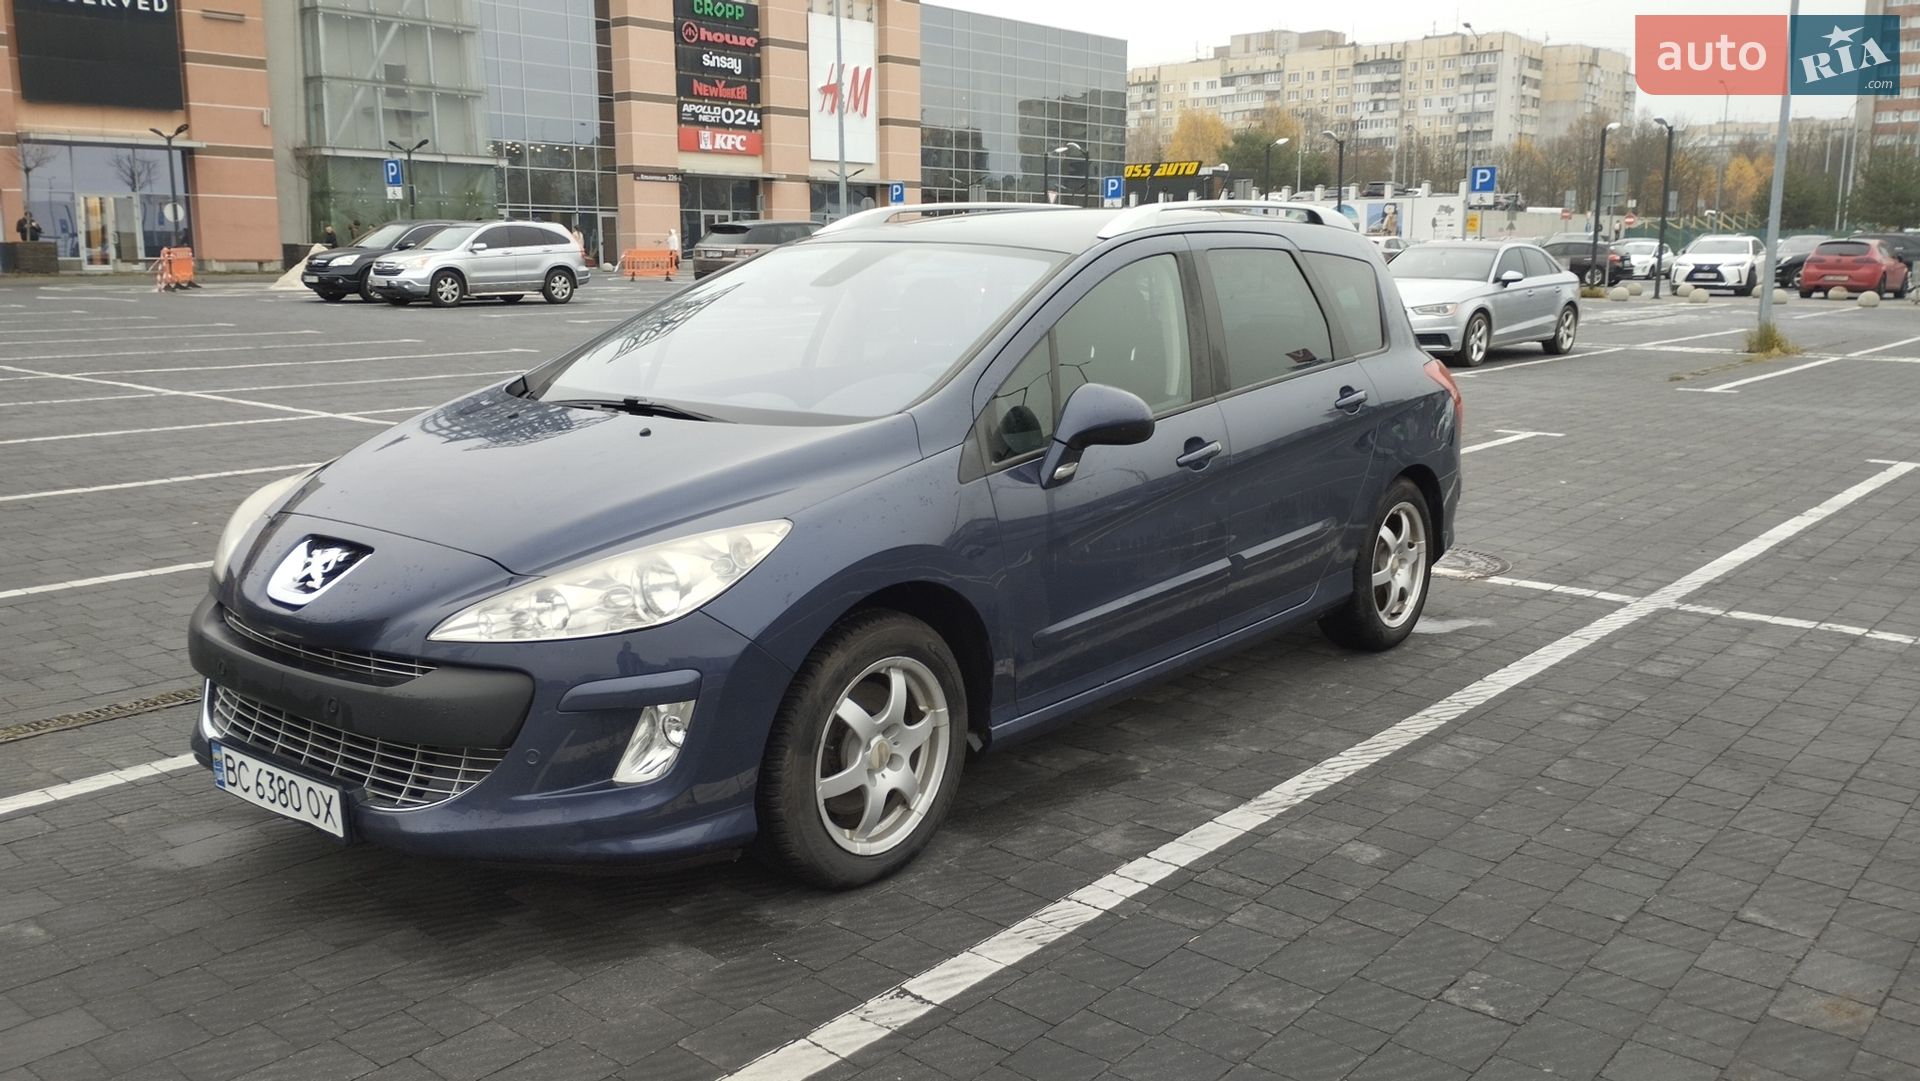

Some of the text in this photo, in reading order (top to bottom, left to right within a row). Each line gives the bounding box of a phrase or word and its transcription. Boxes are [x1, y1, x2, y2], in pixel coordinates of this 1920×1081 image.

[693, 0, 744, 20] CROPP
[702, 51, 742, 75] sinsay
[818, 63, 872, 118] HM
[682, 103, 721, 115] APOLLO
[698, 114, 721, 123] NEXT
[721, 107, 761, 126] 024
[714, 133, 747, 151] KFC
[388, 162, 398, 183] P
[1475, 169, 1491, 190] P
[892, 186, 901, 200] P
[1107, 178, 1119, 197] P
[224, 753, 338, 829] BC 6380 OX
